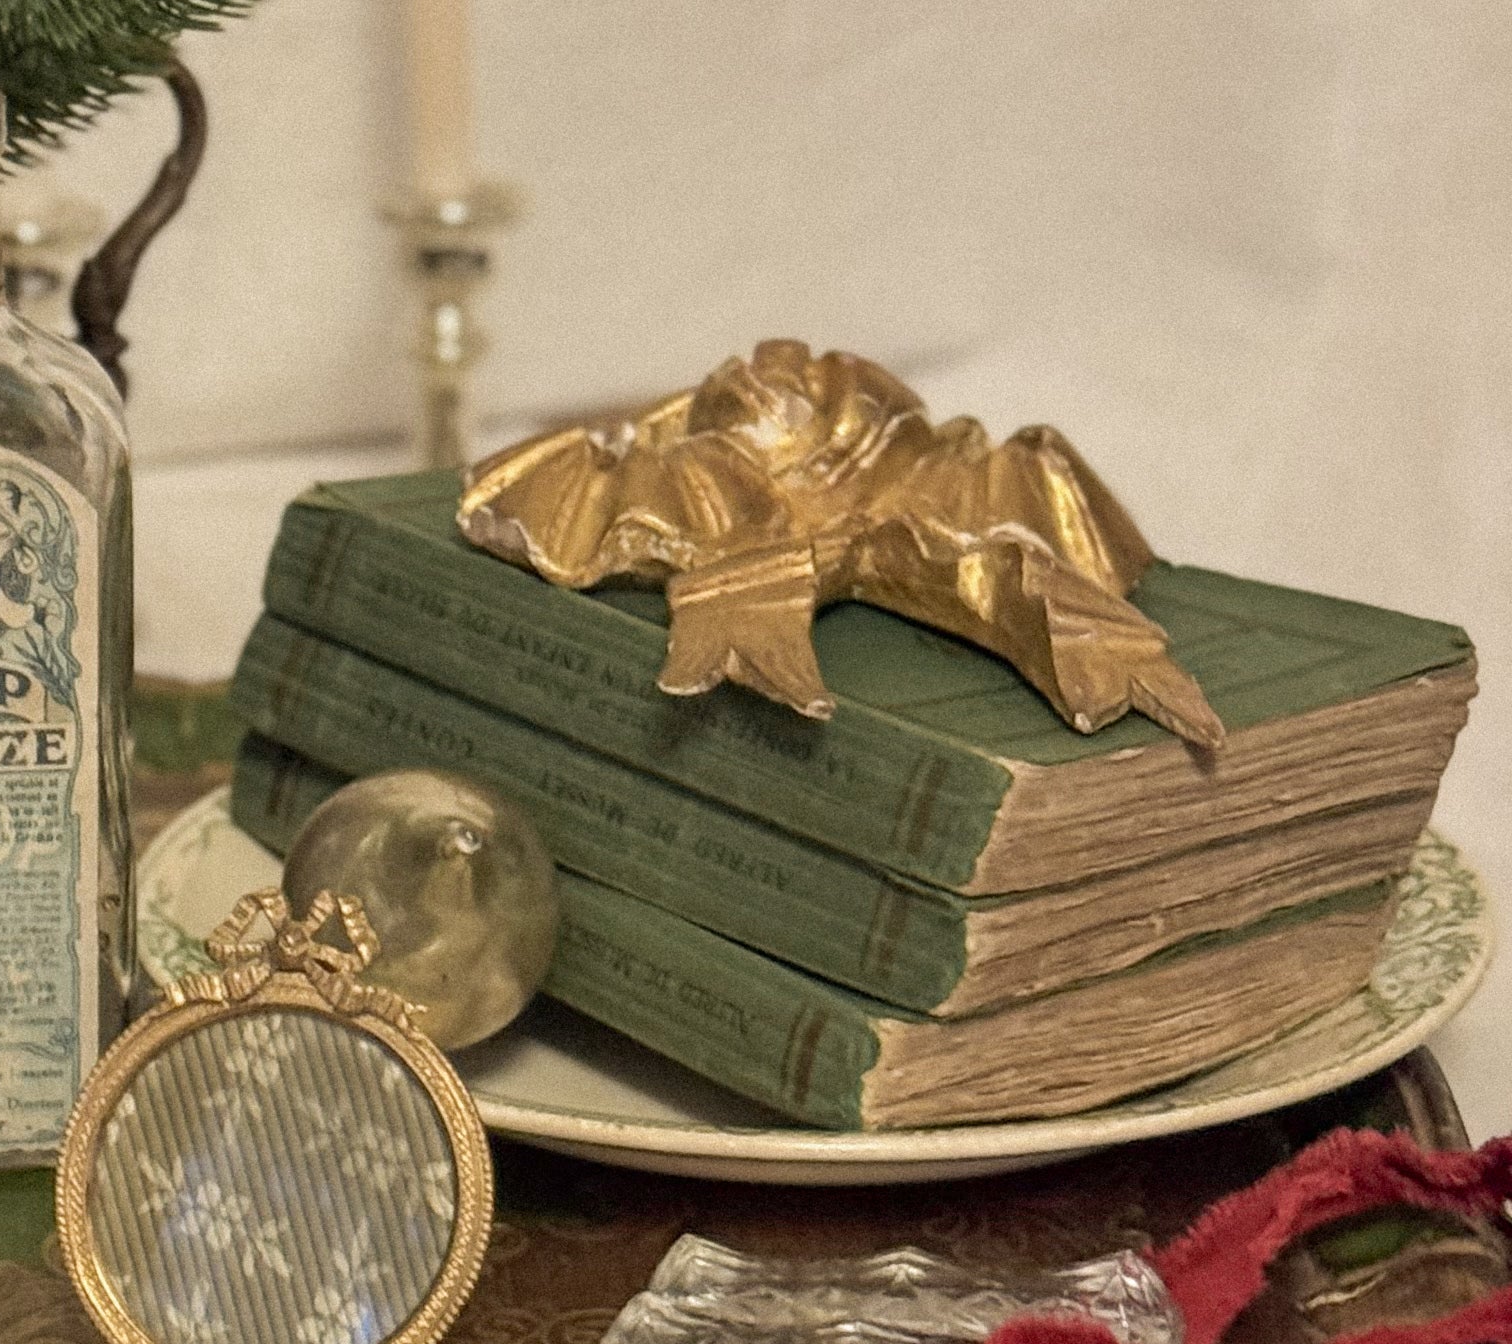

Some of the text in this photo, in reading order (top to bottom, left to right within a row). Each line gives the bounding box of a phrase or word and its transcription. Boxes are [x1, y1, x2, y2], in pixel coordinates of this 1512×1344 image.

[534, 768, 629, 829] MUSSET
[644, 814, 679, 846] DE
[692, 834, 792, 893] ALFRED
